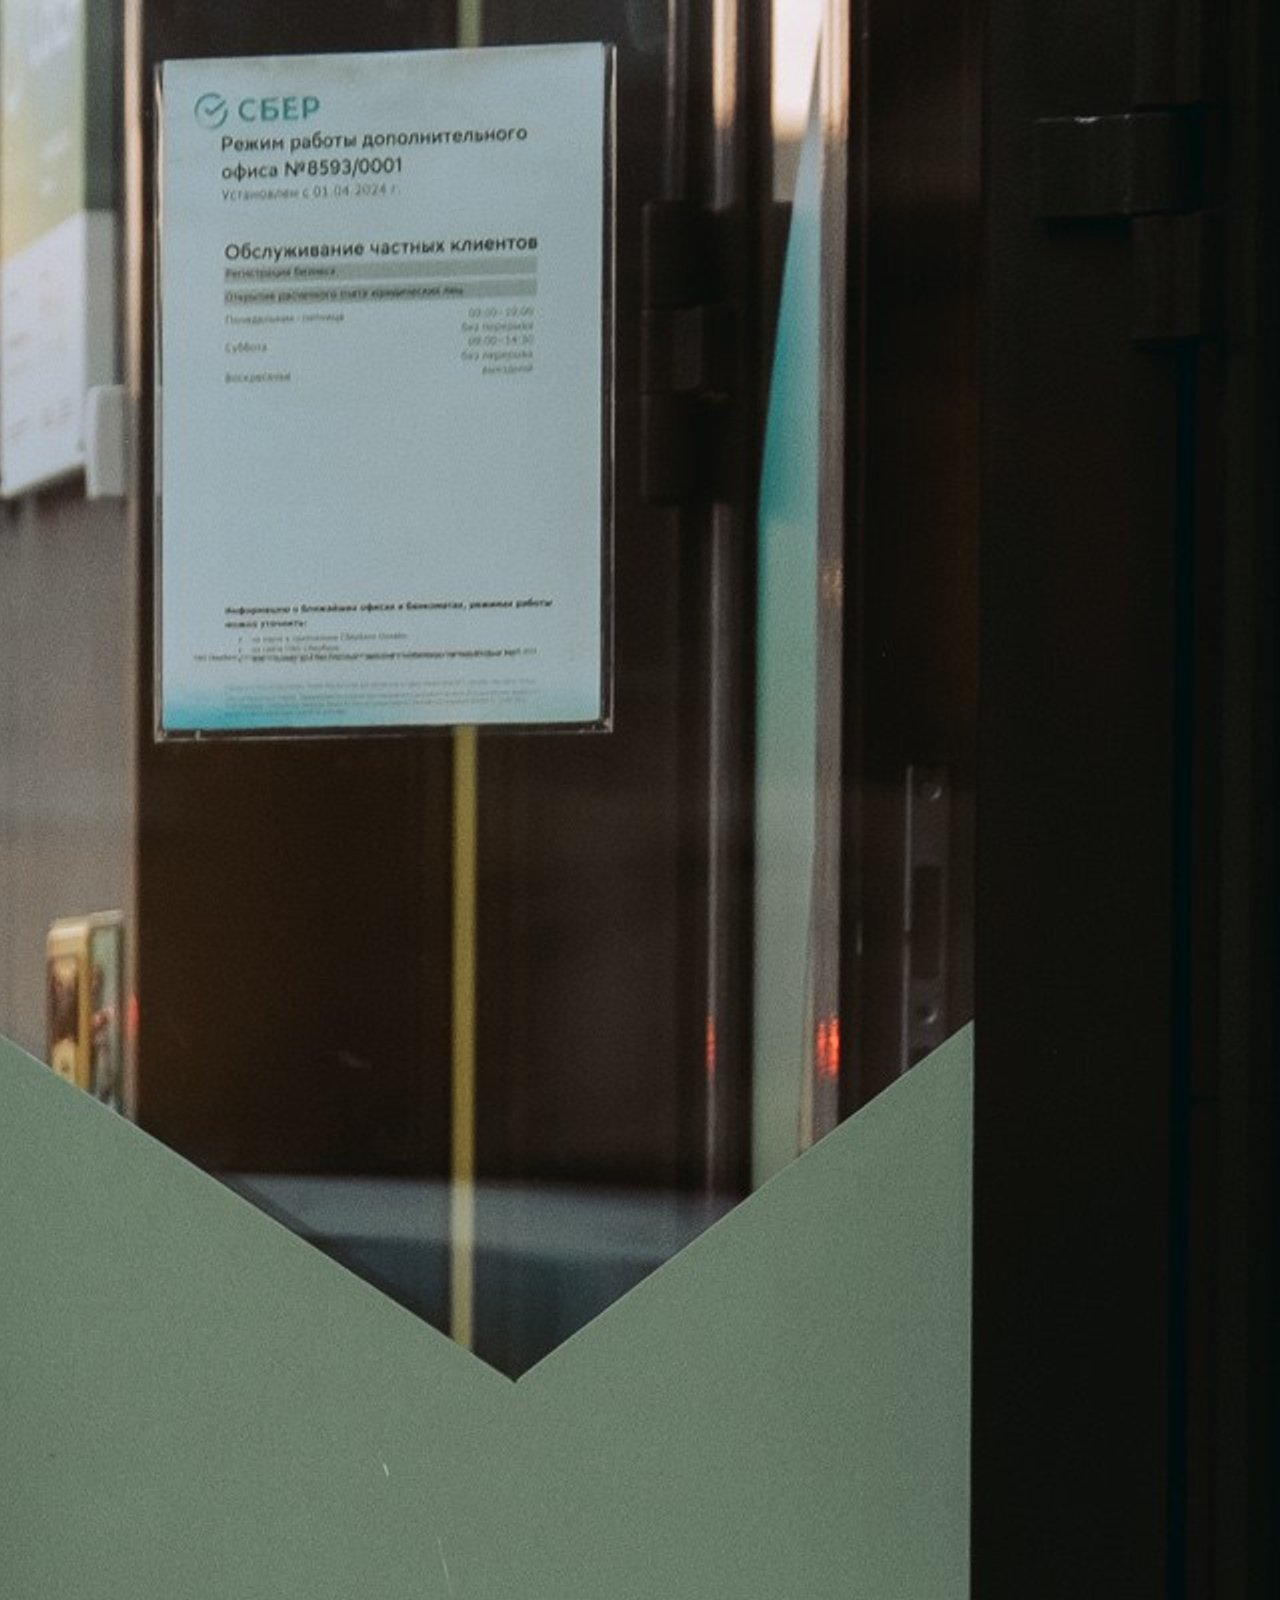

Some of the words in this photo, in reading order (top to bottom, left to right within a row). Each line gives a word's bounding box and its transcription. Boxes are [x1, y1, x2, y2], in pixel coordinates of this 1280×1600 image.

[238, 96, 320, 122] СБЕР
[221, 136, 284, 153] Режим
[290, 131, 356, 153] работы
[362, 126, 528, 150] дополнительного
[221, 160, 278, 181] офиса
[284, 158, 402, 178] №8593/0001
[225, 242, 364, 264] Обслуживание
[370, 239, 445, 255] частных
[451, 236, 538, 253] клиентов
